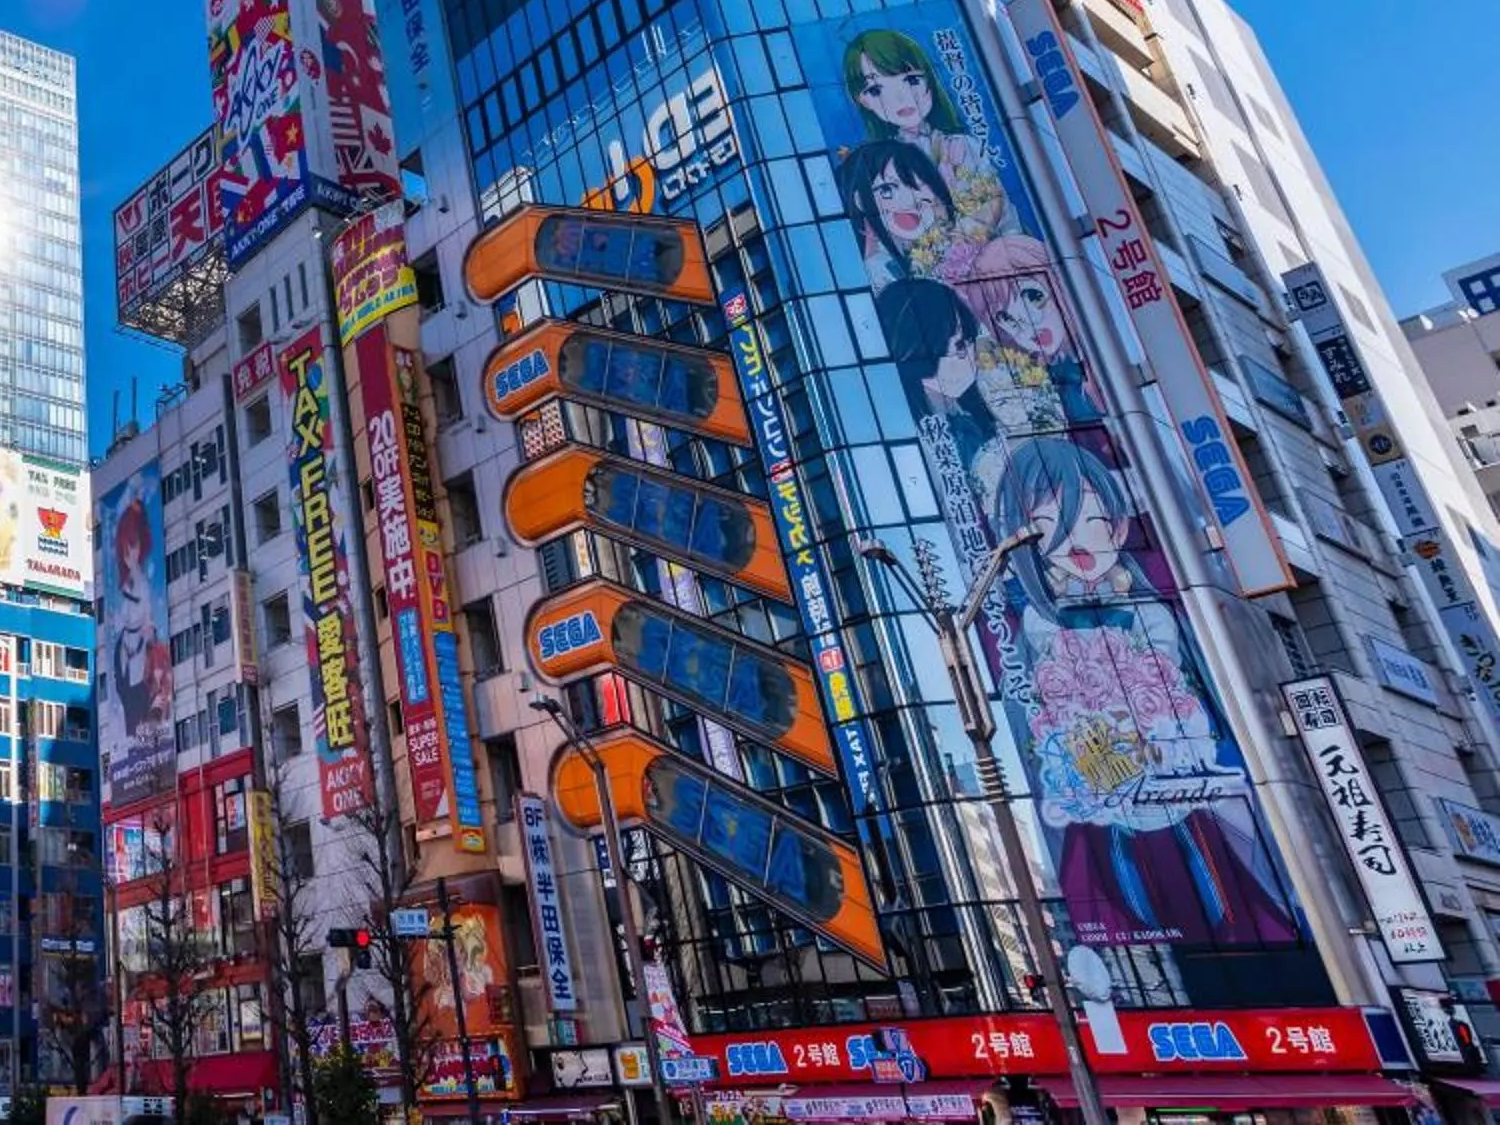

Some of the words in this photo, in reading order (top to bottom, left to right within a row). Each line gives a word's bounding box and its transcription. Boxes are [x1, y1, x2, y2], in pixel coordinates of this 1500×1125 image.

[1026, 30, 1080, 121] SEGA
[1097, 210, 1163, 311] 2号館
[495, 349, 550, 401] SEGA
[290, 347, 326, 449] TAX
[369, 410, 396, 451] 20
[1181, 416, 1252, 529] SEGA
[300, 463, 338, 612] FREE
[539, 612, 602, 659] SEGA
[408, 734, 438, 753] SUPER
[413, 751, 440, 766] SALE
[326, 759, 365, 792] AKKY
[1104, 774, 1224, 809] Arcade
[332, 788, 364, 813] ONE
[726, 1041, 788, 1076] SEGA
[794, 1043, 841, 1068] 2号館
[971, 1032, 1035, 1059] 2号館
[1149, 1021, 1248, 1061] SEGA
[1266, 1026, 1336, 1055] 2号館
